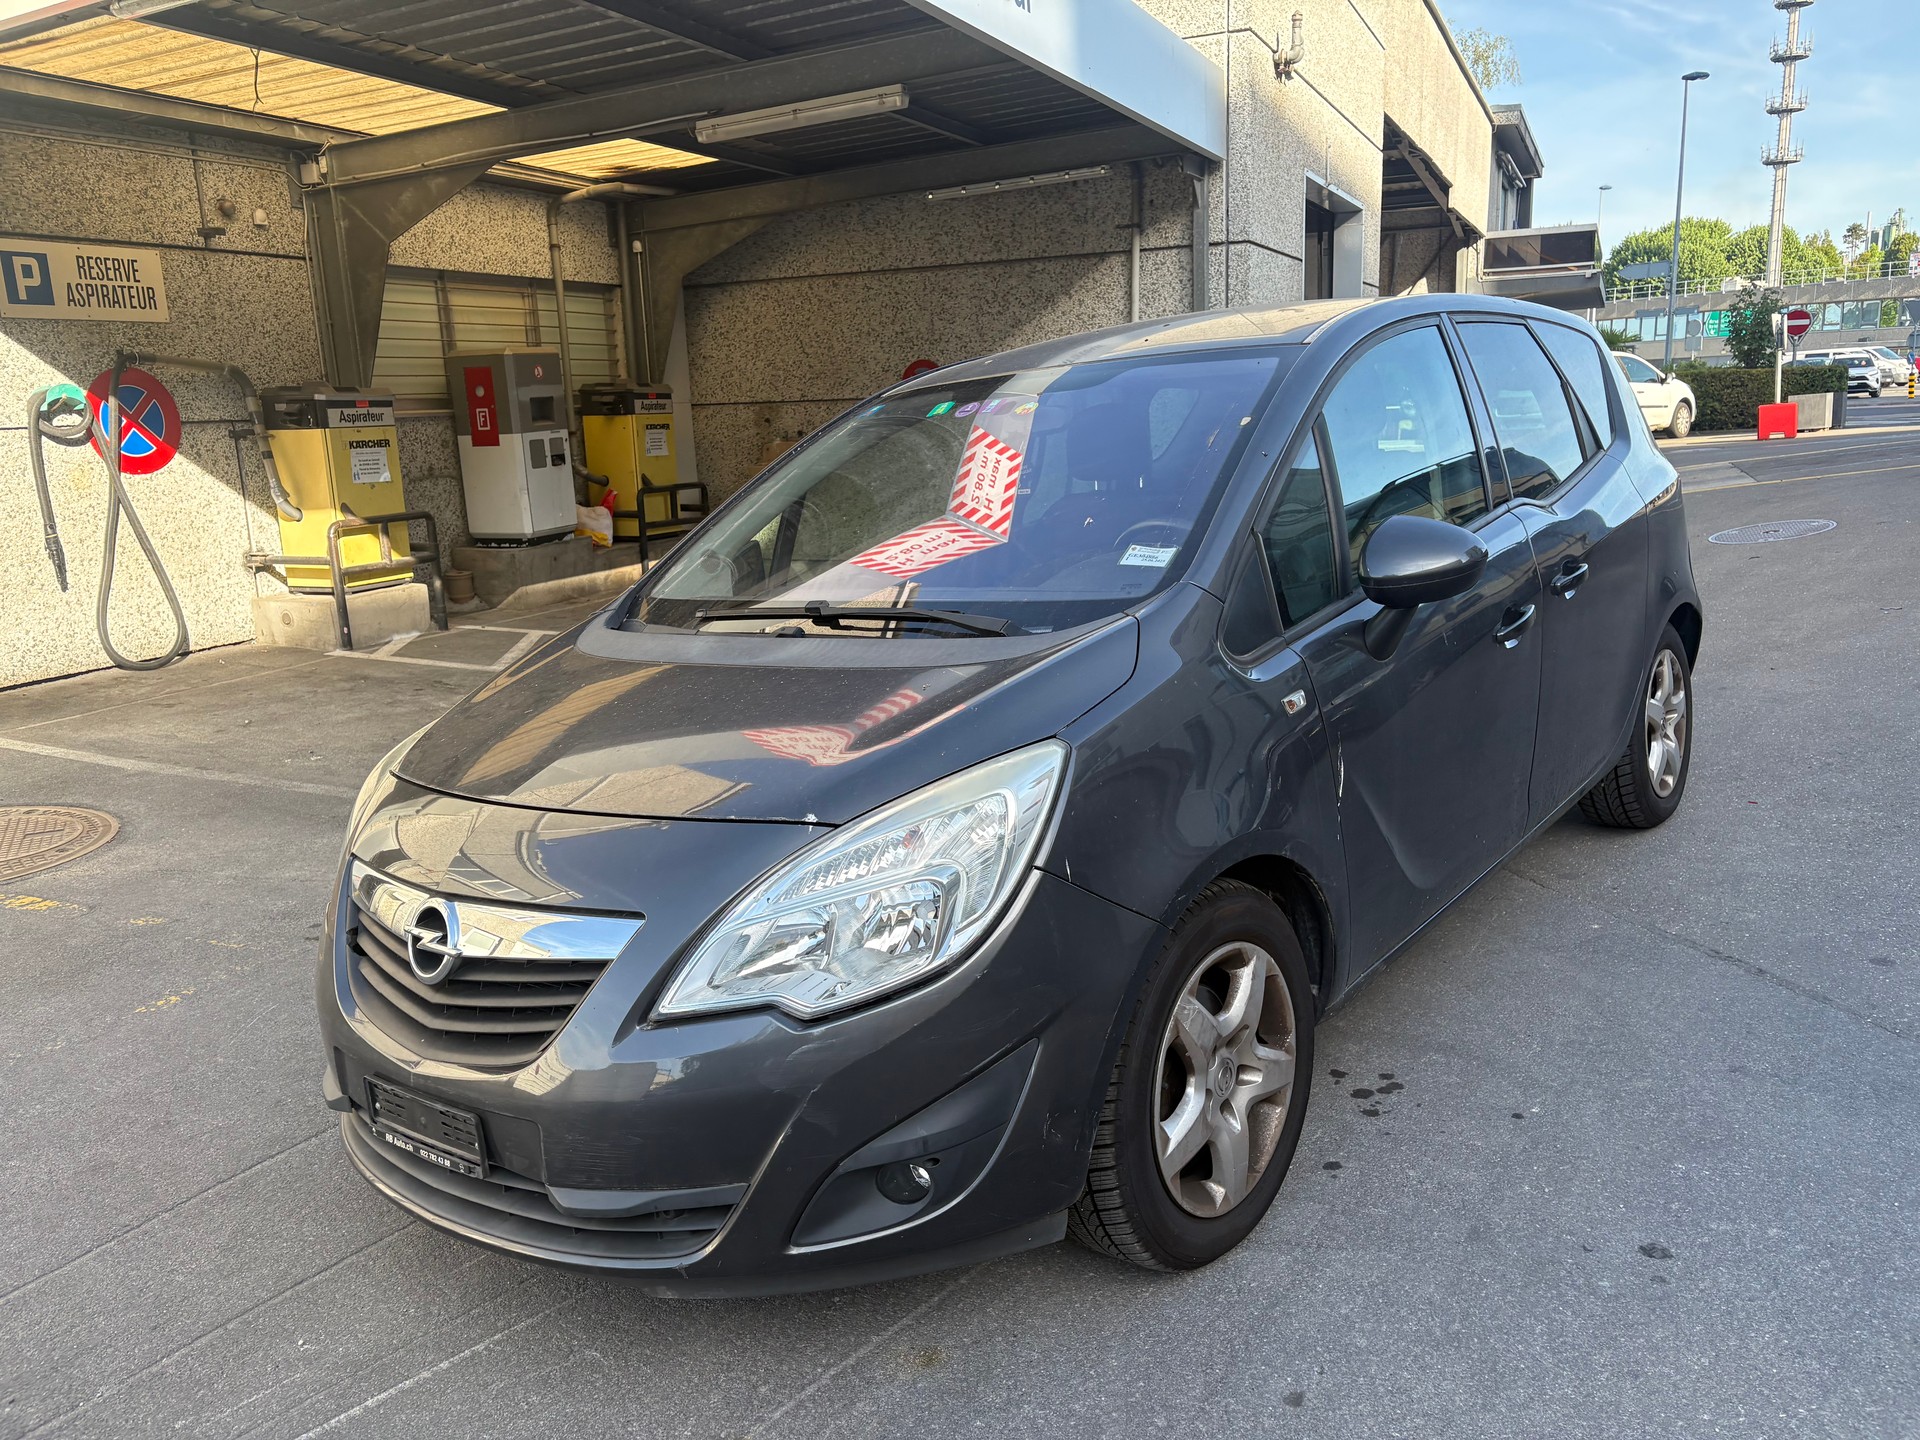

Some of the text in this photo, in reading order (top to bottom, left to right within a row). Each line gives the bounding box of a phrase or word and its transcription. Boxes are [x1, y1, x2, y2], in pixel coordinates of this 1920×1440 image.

[11, 255, 42, 300] P
[75, 254, 141, 283] RESERVE
[66, 282, 158, 311] ASPIRATEUR
[339, 409, 385, 425] Aspirateur
[641, 401, 666, 412] Aspirateur
